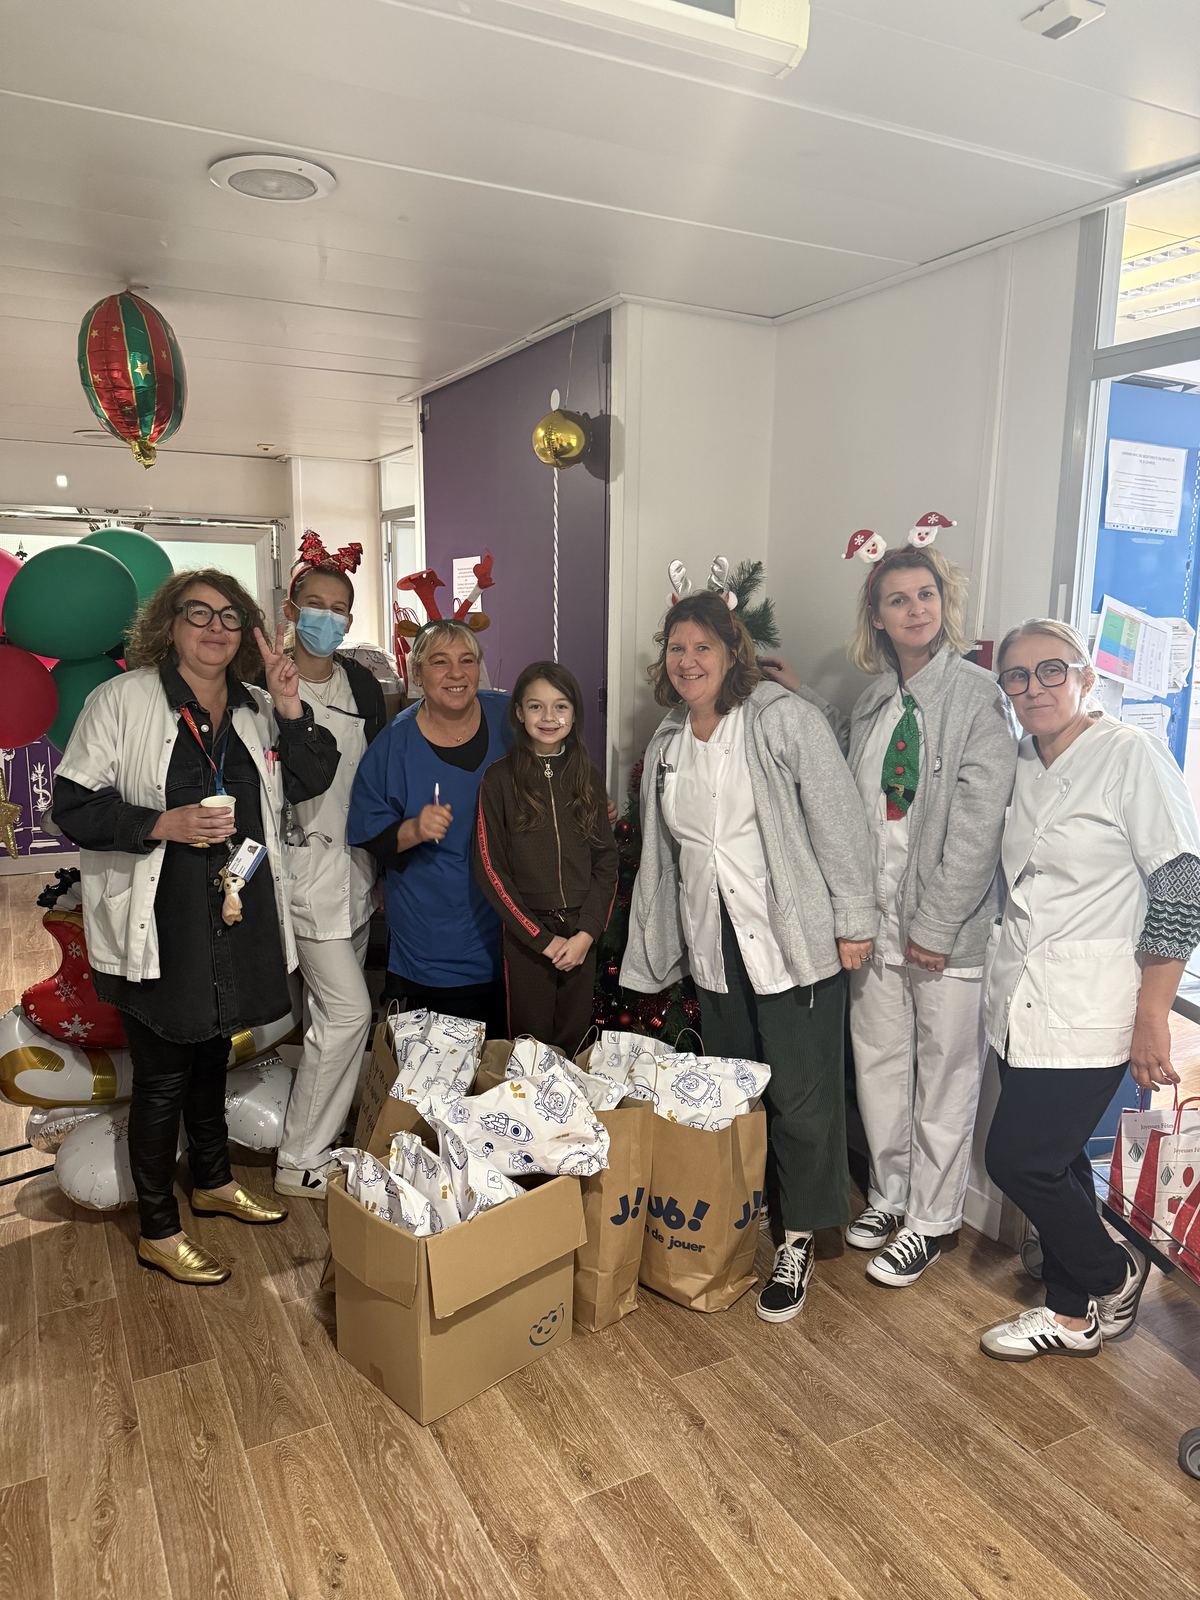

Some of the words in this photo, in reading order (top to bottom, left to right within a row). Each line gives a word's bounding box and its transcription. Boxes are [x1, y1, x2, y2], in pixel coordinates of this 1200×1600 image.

[525, 920, 538, 934] KORS
[652, 1228, 664, 1243] de
[667, 1236, 705, 1253] jouer
